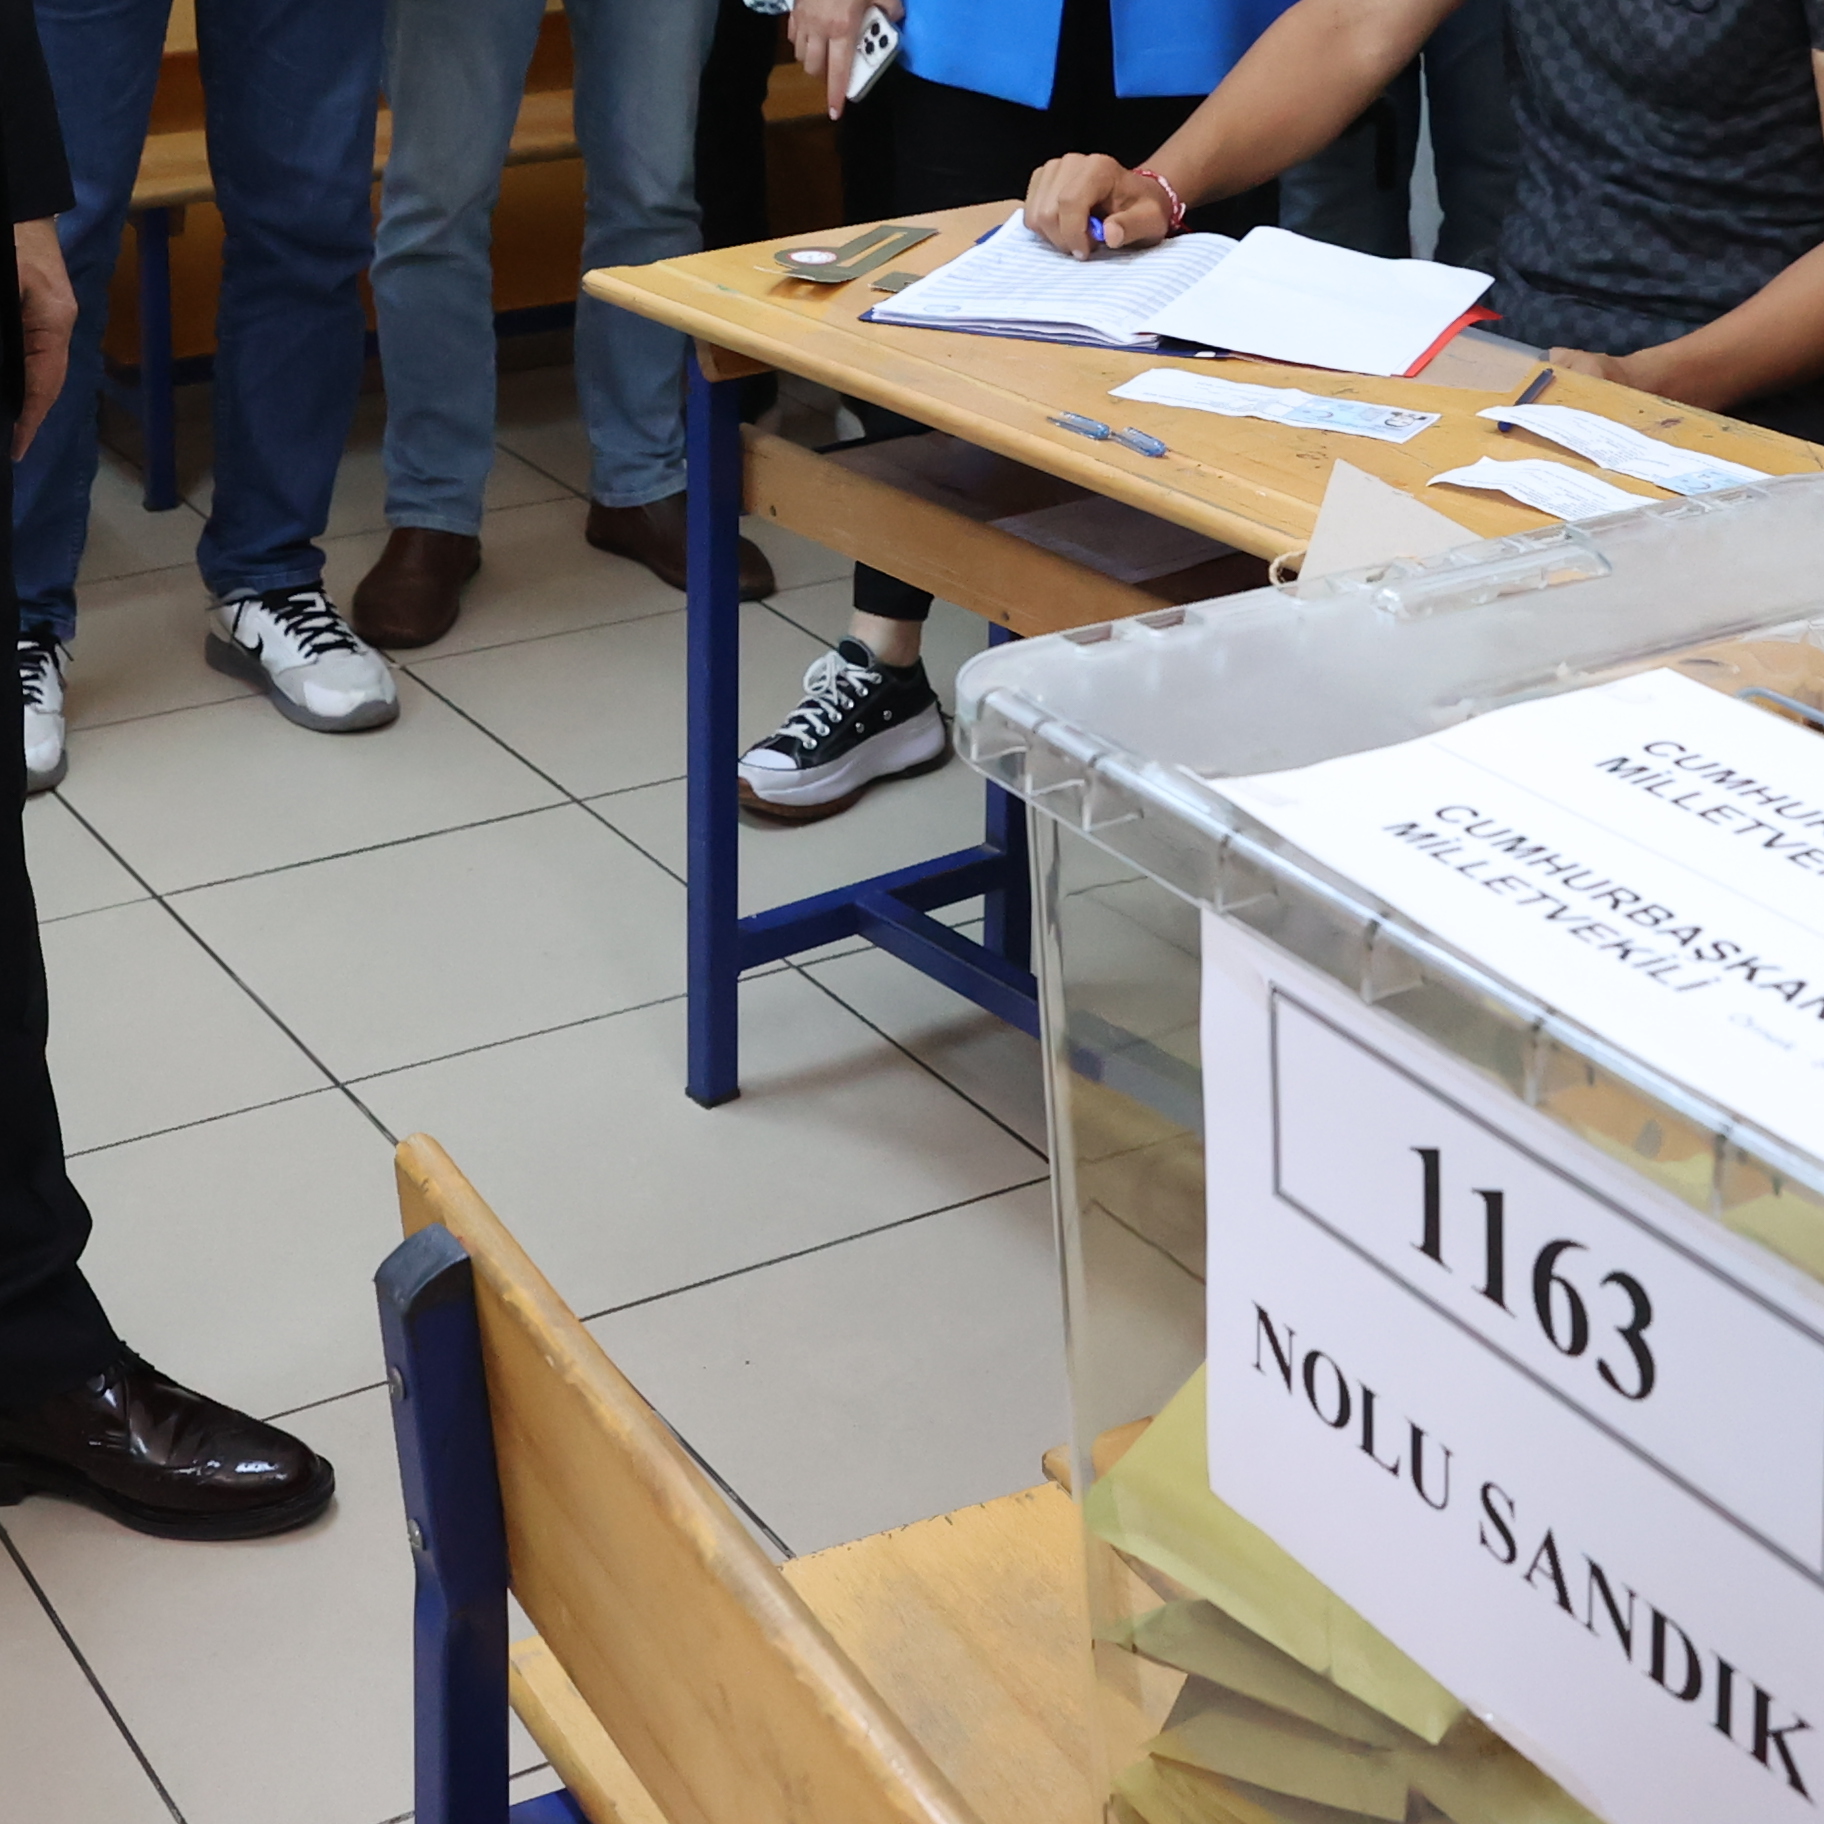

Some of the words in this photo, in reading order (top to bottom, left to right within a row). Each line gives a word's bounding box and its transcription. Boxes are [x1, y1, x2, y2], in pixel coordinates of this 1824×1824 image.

[1383, 821, 1718, 993] MİLLETVEKİLİ
[1411, 1146, 1657, 1402] 1163
[1252, 1302, 1452, 1511] NOLU
[1480, 1481, 1814, 1804] SANDIK
